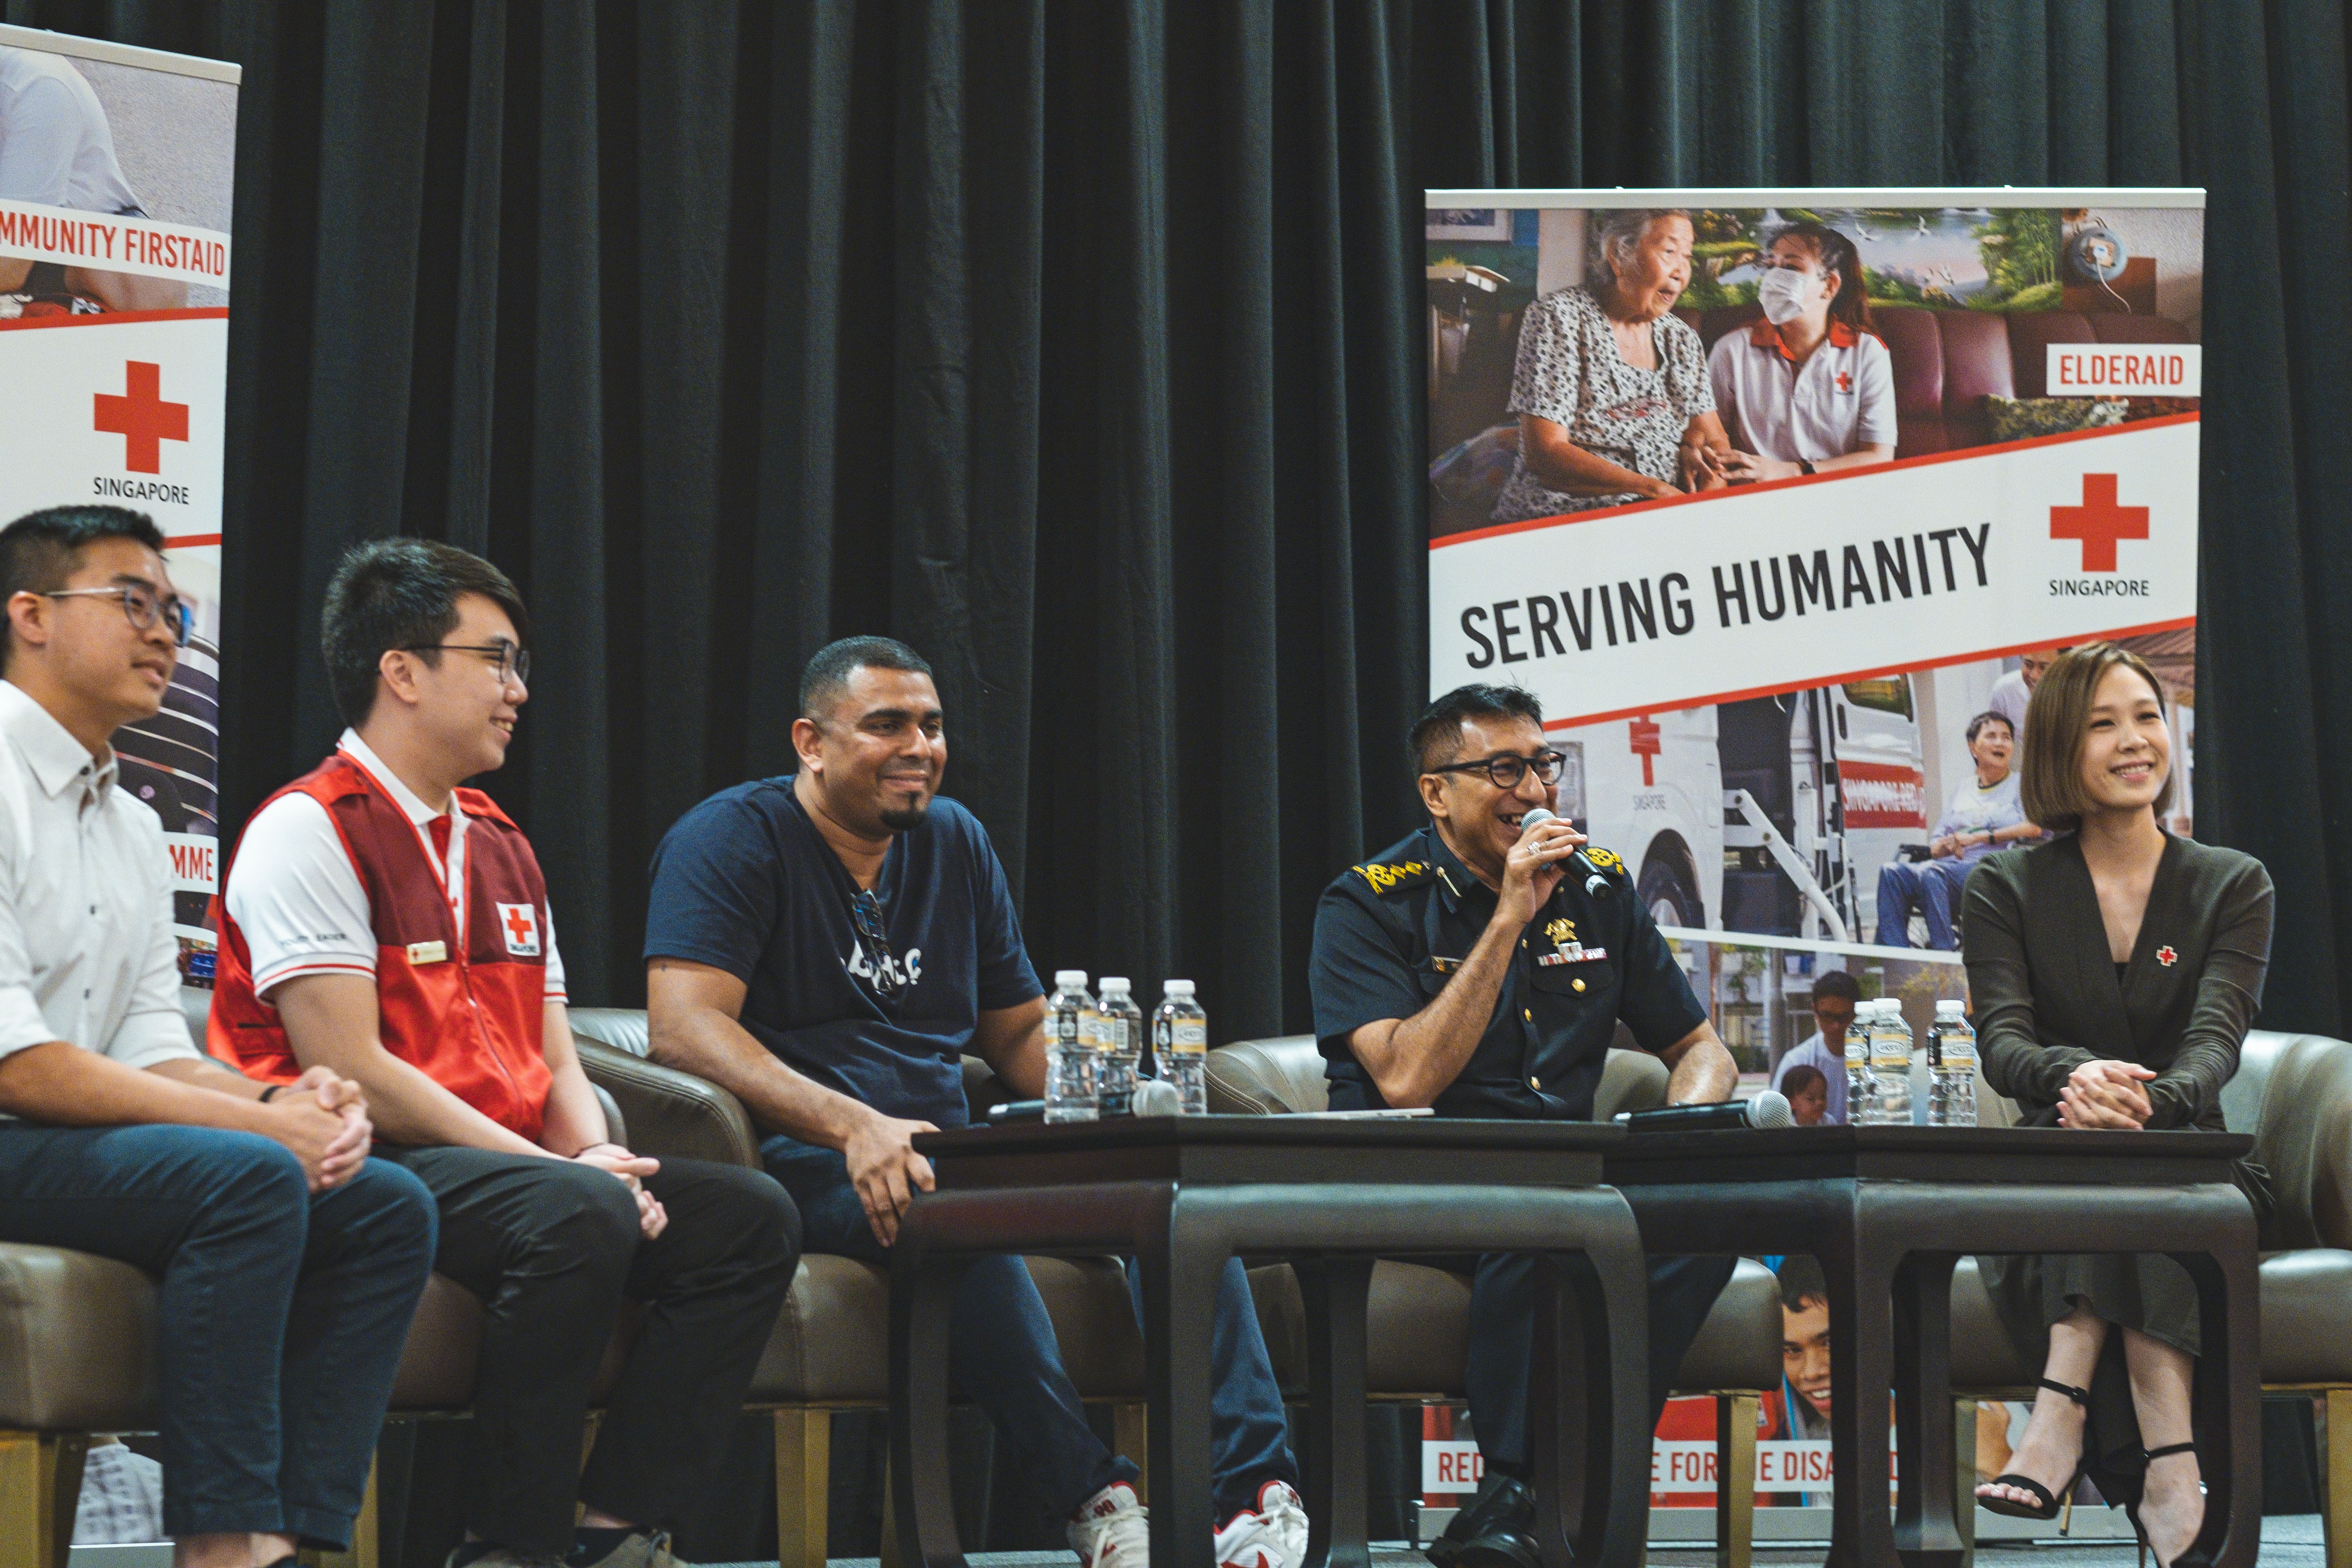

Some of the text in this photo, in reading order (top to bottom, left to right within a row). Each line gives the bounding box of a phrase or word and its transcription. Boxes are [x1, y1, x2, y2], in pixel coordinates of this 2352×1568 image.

[125, 228, 224, 276] FIRSTAID
[2060, 355, 2184, 385] ELDERAID
[93, 476, 190, 505] SINGAPORE
[1460, 522, 1990, 669] SERVING HUMANITY
[2049, 579, 2149, 596] SINGAPORE
[1439, 1452, 1484, 1482] RED
[1671, 1452, 1718, 1482] FOR
